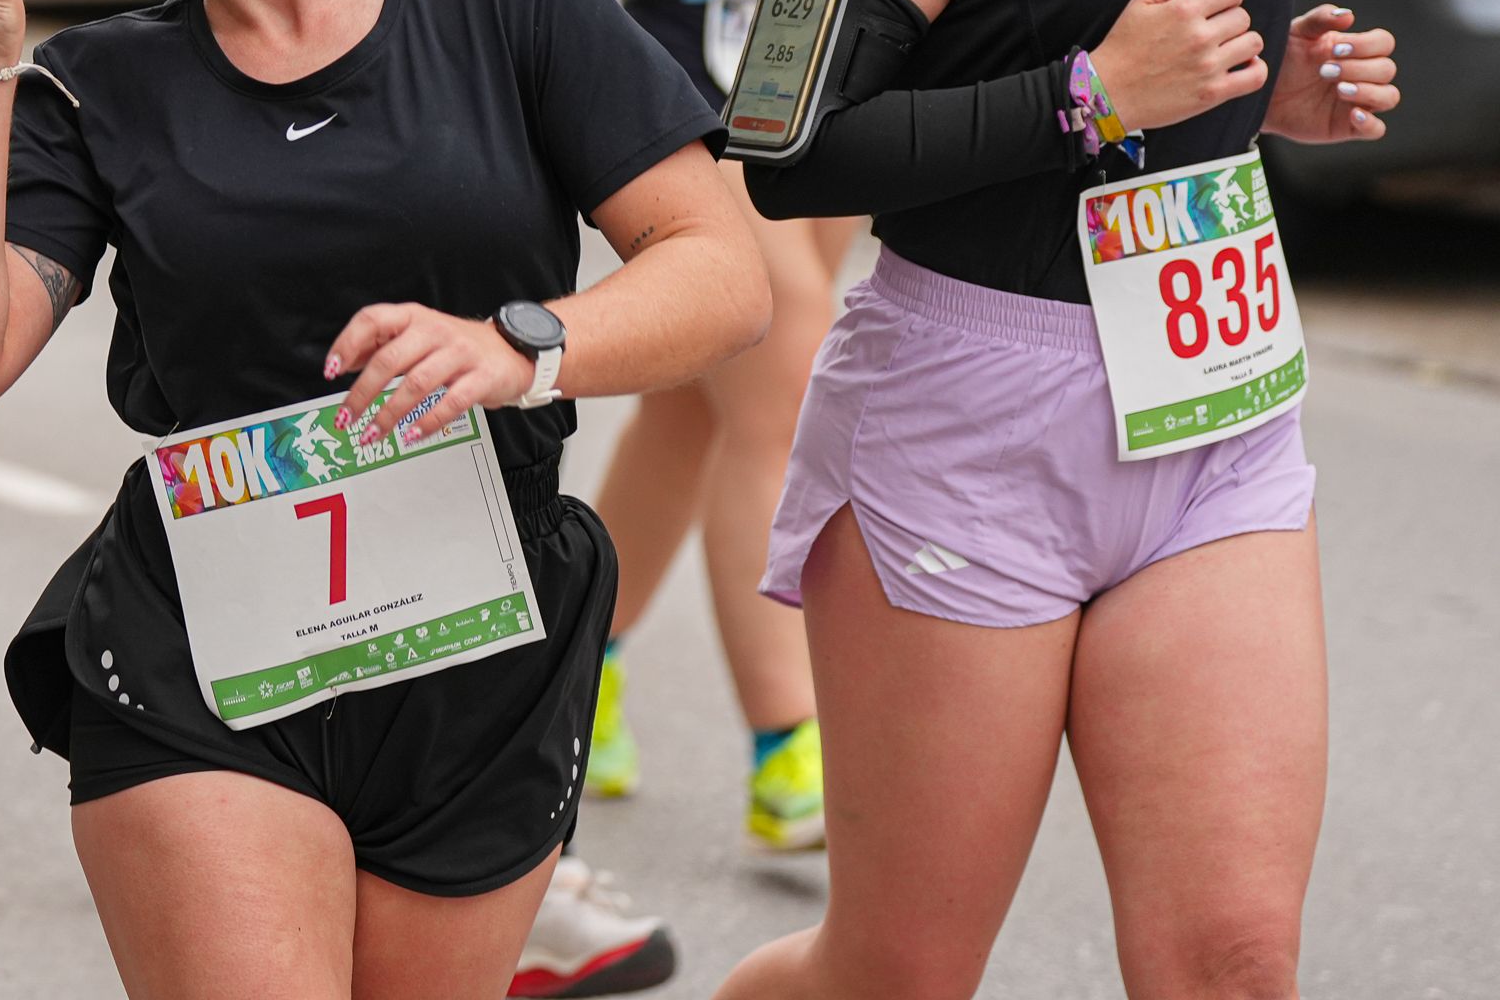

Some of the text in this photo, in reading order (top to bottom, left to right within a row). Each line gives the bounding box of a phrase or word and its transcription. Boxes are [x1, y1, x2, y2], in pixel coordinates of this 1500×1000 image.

[764, 43, 795, 64] 2,85
[1107, 181, 1199, 255] 10K
[1158, 231, 1281, 359] 835
[182, 428, 281, 508] 10K
[353, 438, 395, 467] 2026
[293, 493, 347, 605] 7
[296, 592, 424, 638] ELENA AGUILAR GONZÁLEZ
[340, 623, 379, 641] TALLA M
